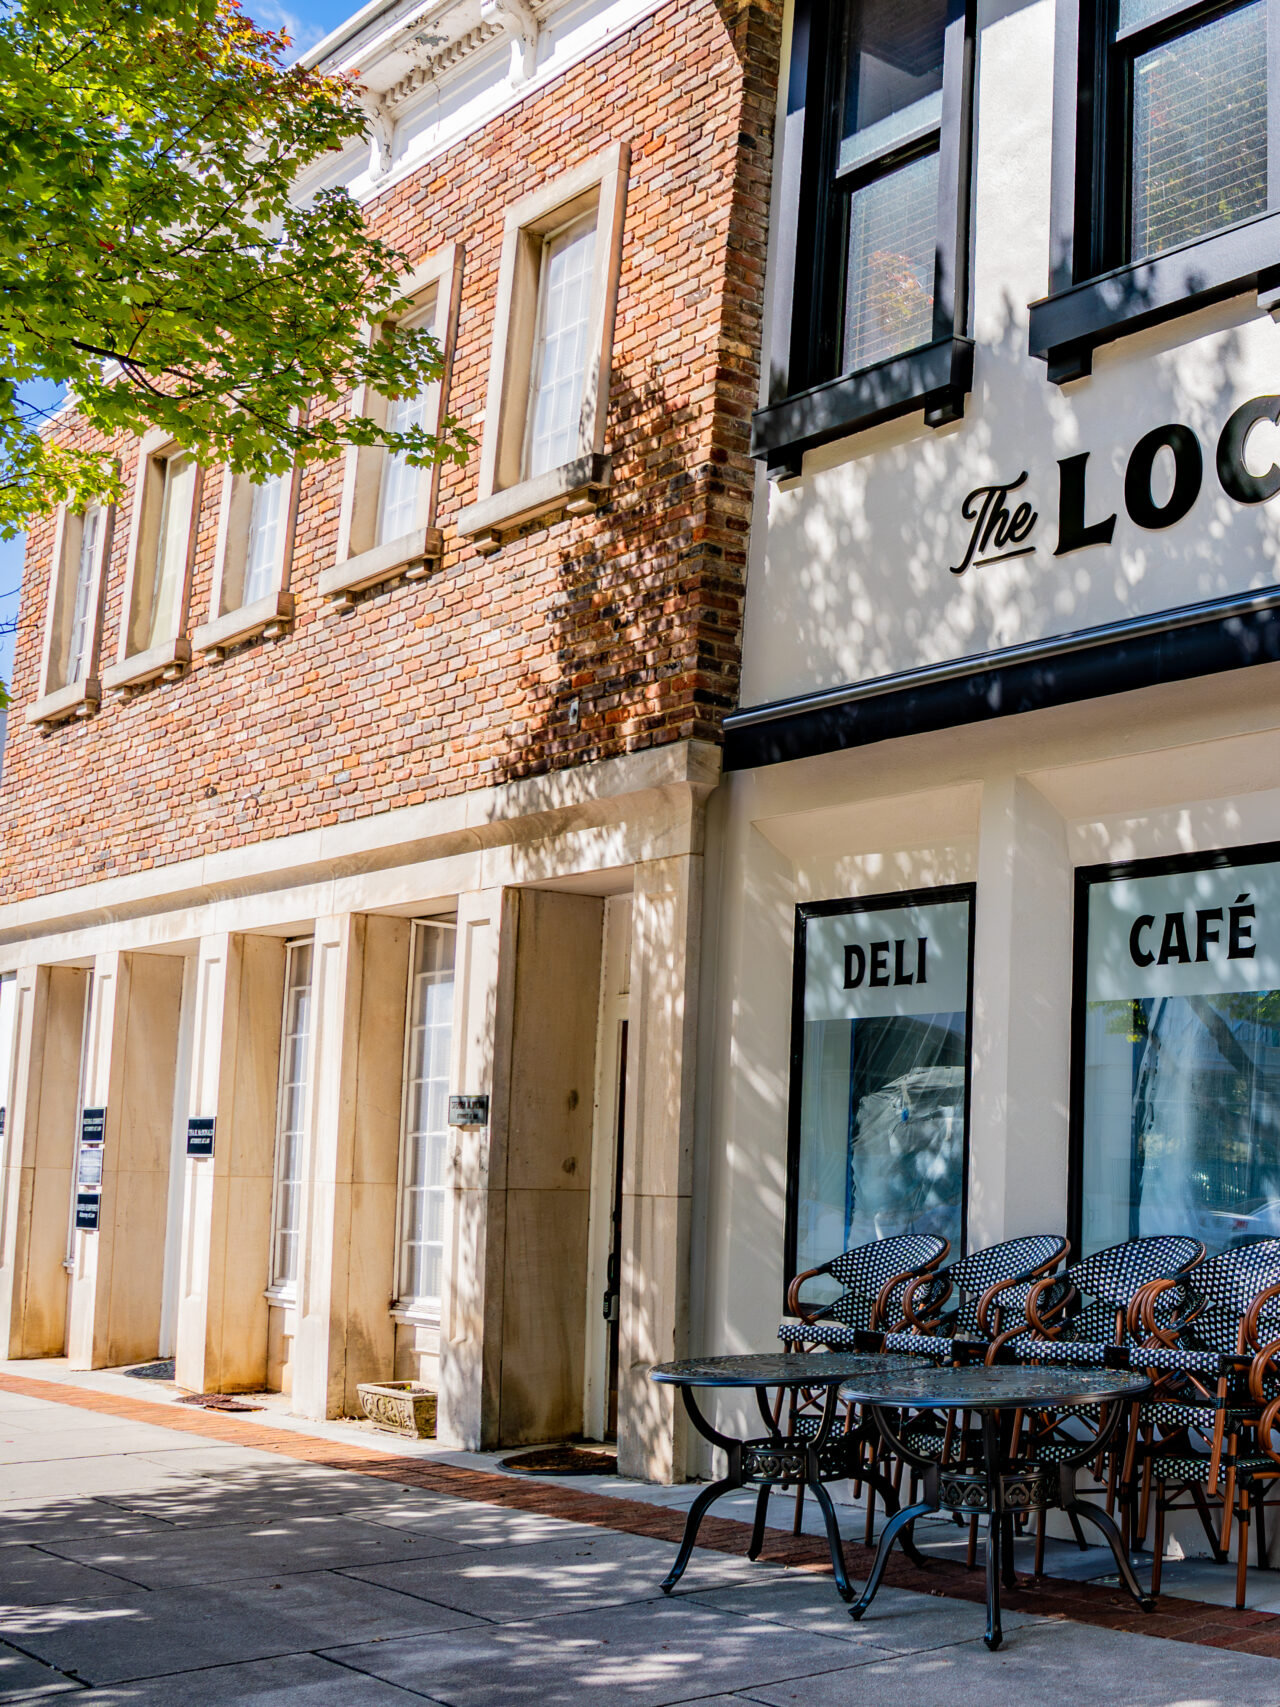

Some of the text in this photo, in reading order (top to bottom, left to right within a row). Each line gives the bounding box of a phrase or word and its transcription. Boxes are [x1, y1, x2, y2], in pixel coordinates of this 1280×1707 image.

[950, 471, 1038, 575] The
[843, 936, 928, 990] DELI
[1129, 893, 1257, 967] CAFÉ
